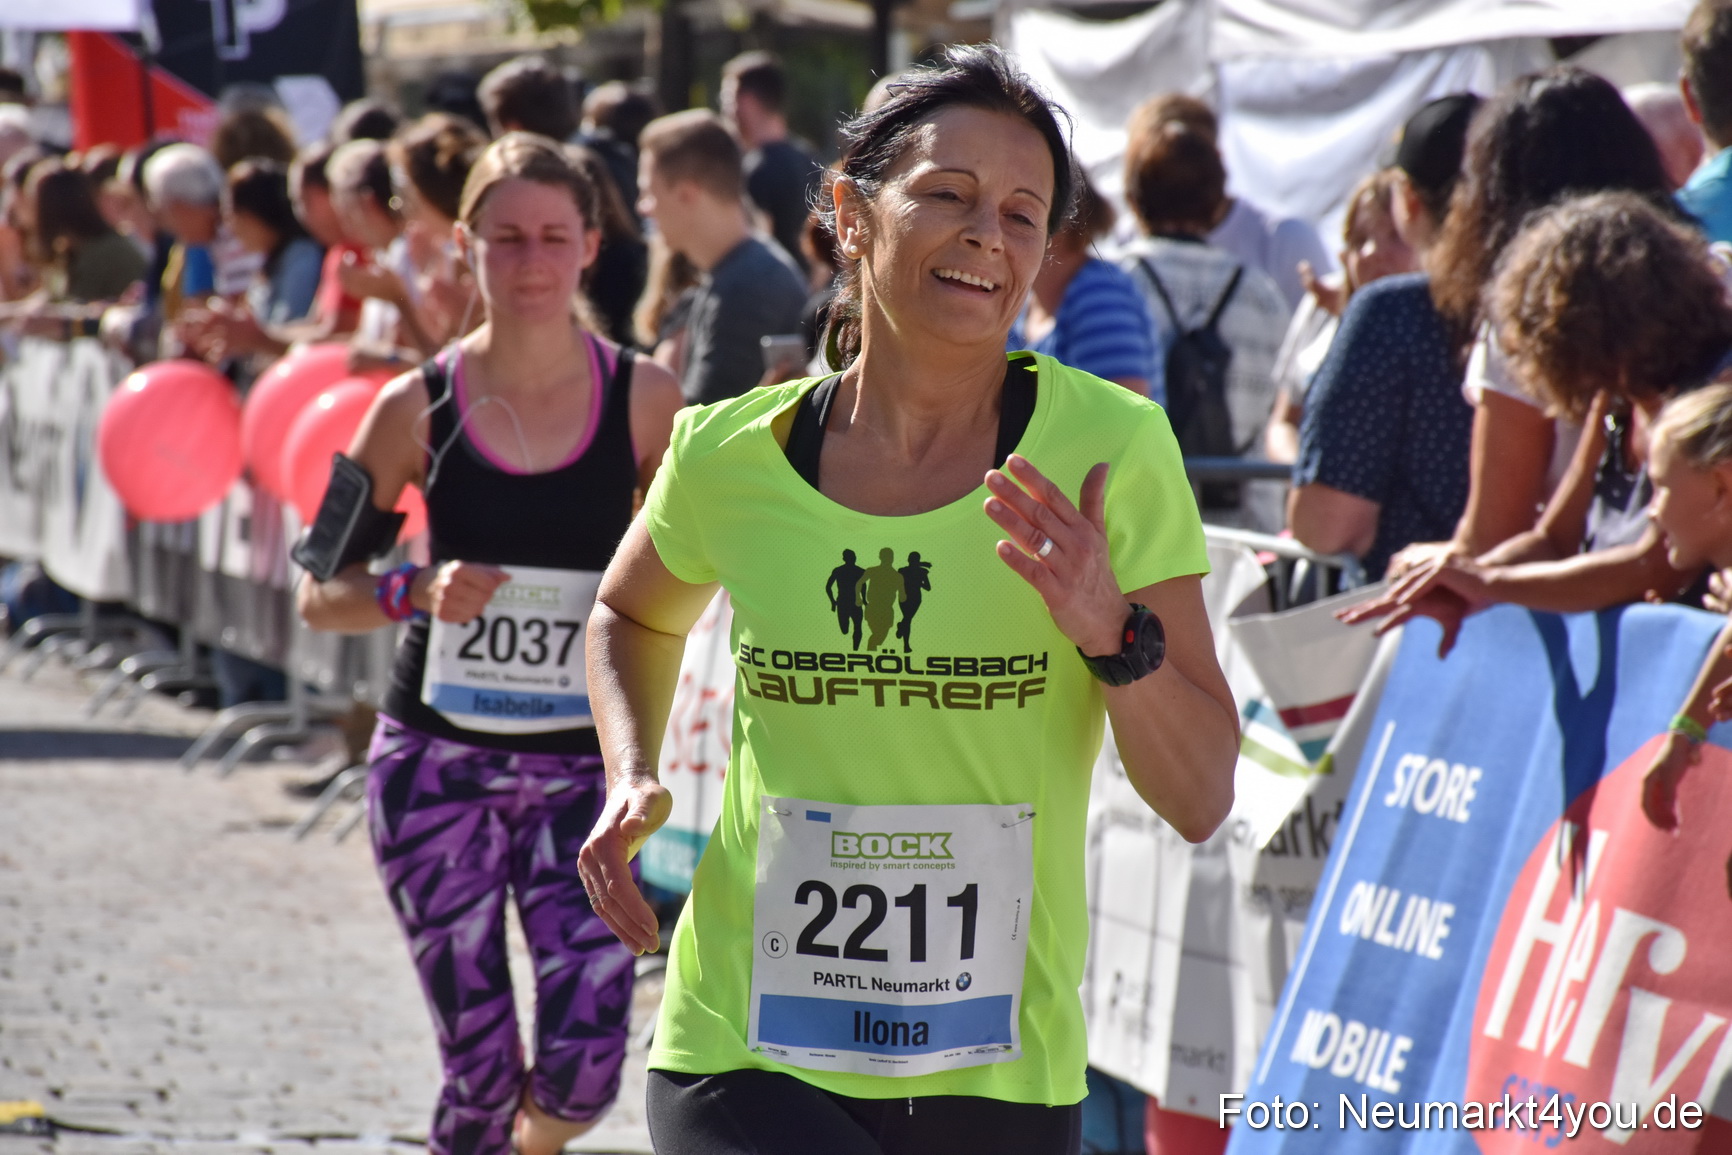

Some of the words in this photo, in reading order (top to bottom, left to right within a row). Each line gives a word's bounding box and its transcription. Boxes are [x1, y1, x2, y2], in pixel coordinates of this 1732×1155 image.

[457, 614, 581, 667] 2037
[739, 643, 766, 668] SC
[474, 693, 555, 718] Isabella
[1384, 752, 1483, 823] STORE
[832, 831, 954, 859] BOCK
[830, 860, 866, 870] inspired
[868, 861, 880, 871] by
[883, 862, 911, 870] smart
[913, 861, 956, 871] concepts
[794, 880, 979, 962] 2211
[1339, 881, 1455, 961] ONLINE
[813, 971, 868, 990] PARTL
[872, 976, 951, 993] Neumarkt
[854, 1010, 930, 1047] Ilona
